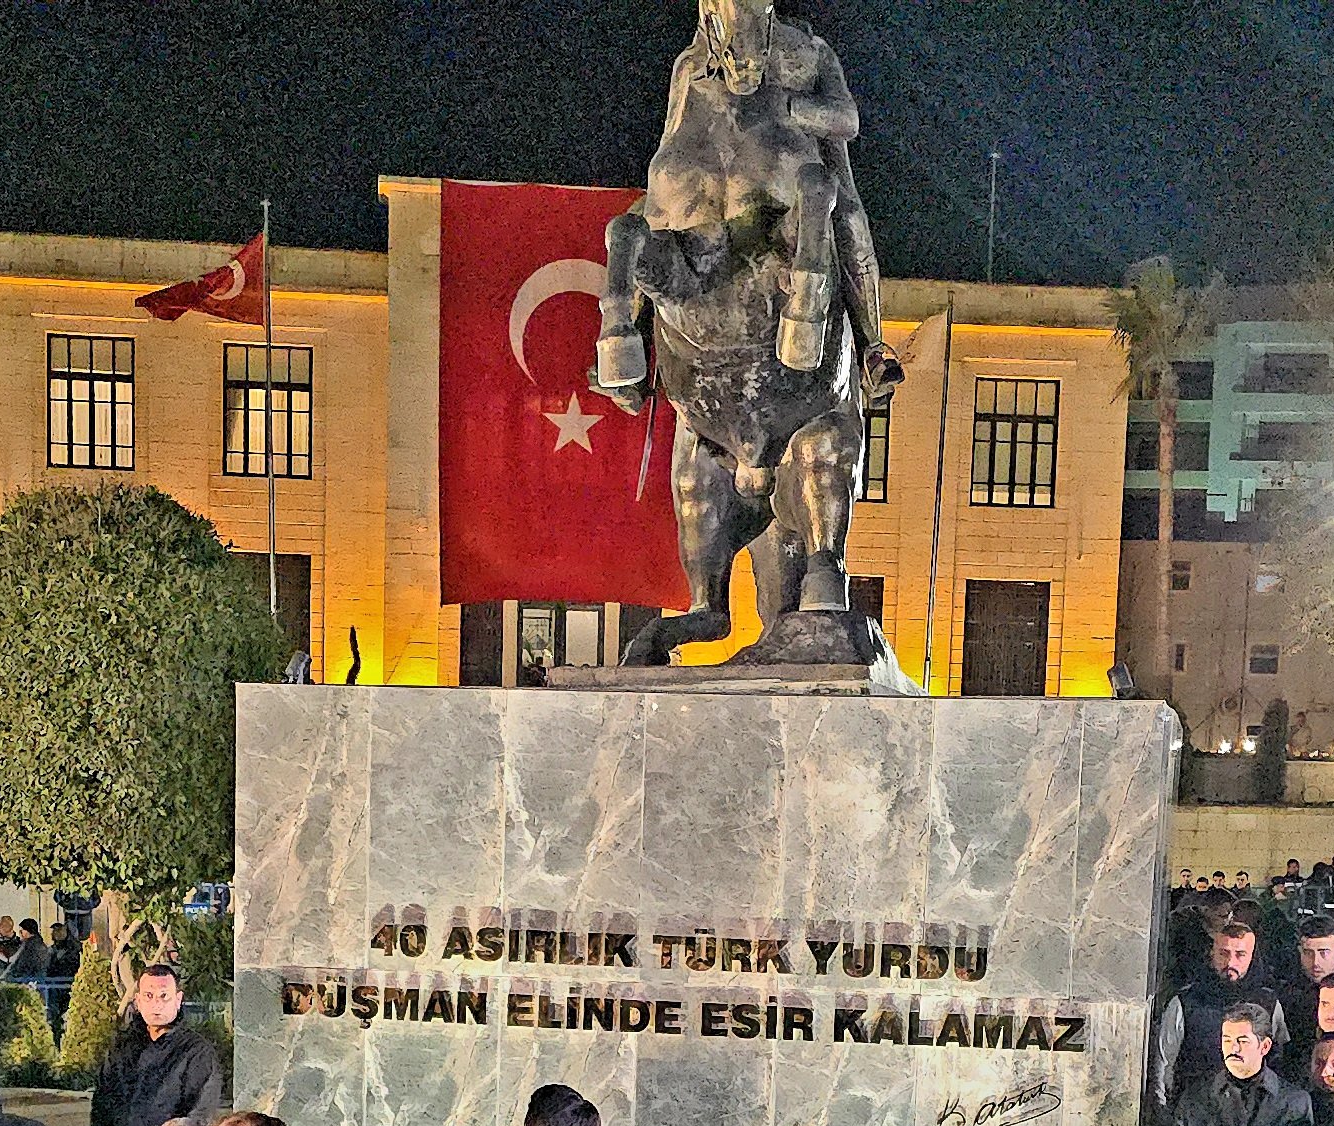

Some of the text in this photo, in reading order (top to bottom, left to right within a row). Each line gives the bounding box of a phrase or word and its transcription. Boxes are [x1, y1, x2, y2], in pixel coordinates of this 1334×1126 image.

[371, 924, 989, 983] 40 ASIRLIK TÜRK YURDU
[282, 974, 1086, 1054] DÜŞMAN ELİNDE ESİR KALAMAZ
